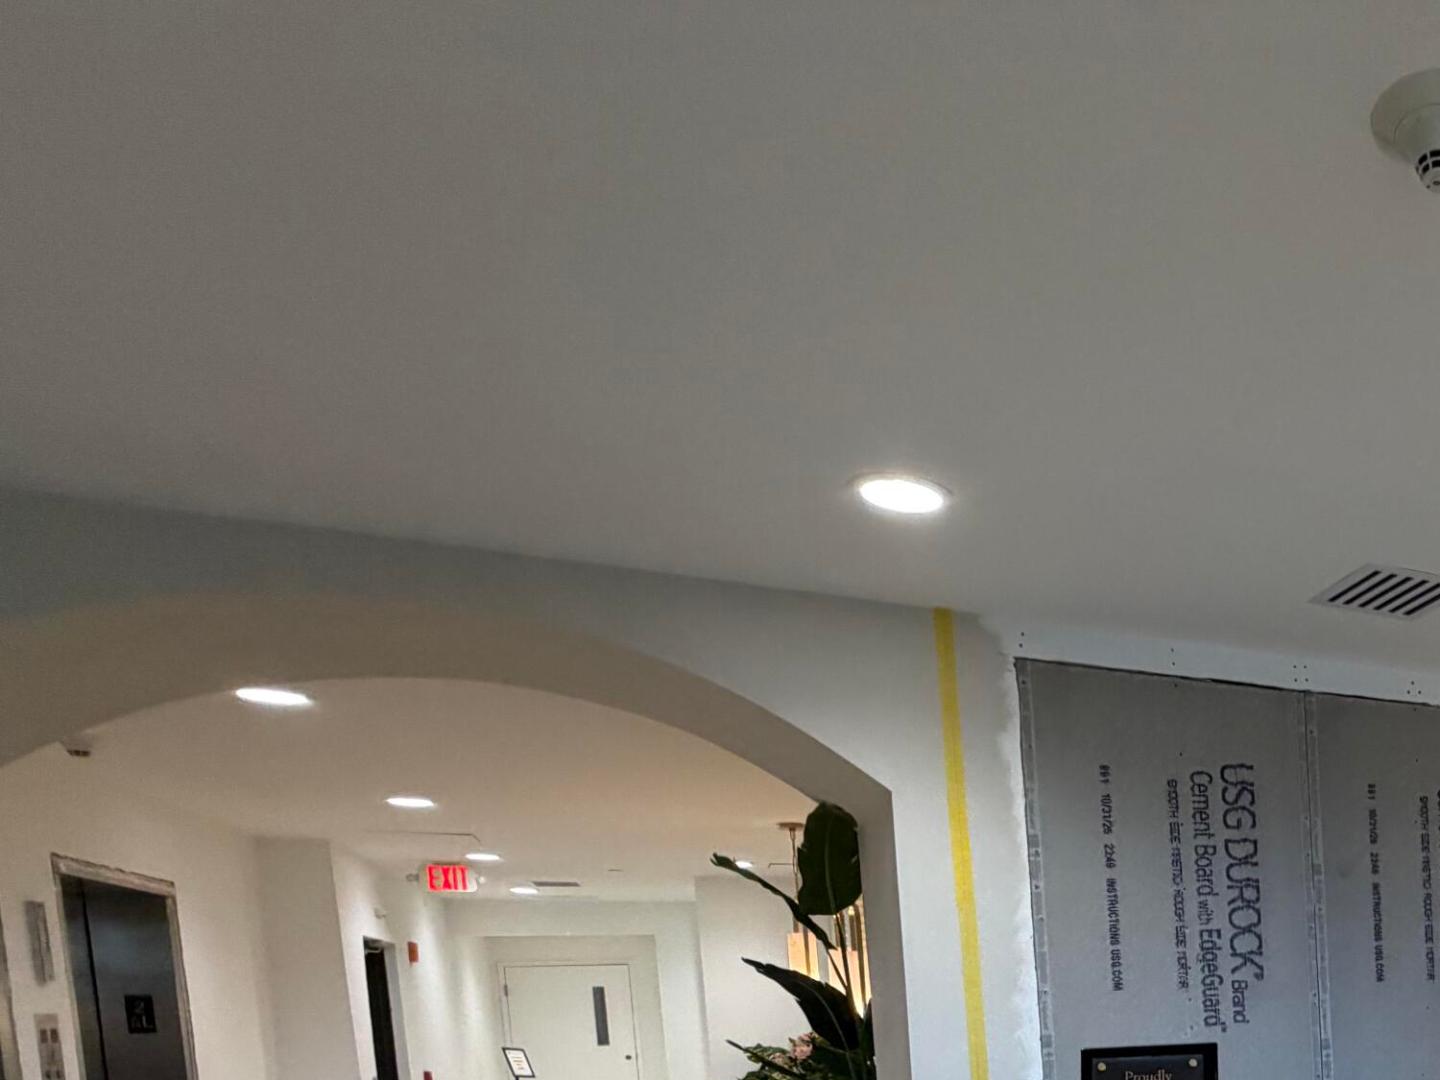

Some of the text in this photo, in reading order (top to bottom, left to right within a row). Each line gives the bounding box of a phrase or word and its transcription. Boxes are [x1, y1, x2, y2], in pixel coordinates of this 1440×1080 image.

[1190, 771, 1215, 839] Cement
[1220, 763, 1256, 830] USG
[427, 865, 468, 891] EXIT
[1194, 845, 1218, 896] Board
[1106, 878, 1120, 945] INSTRUCTIONS
[1197, 900, 1214, 925] with
[1371, 883, 1382, 941] INSTRUCTIONS
[1231, 980, 1249, 1024] Brand
